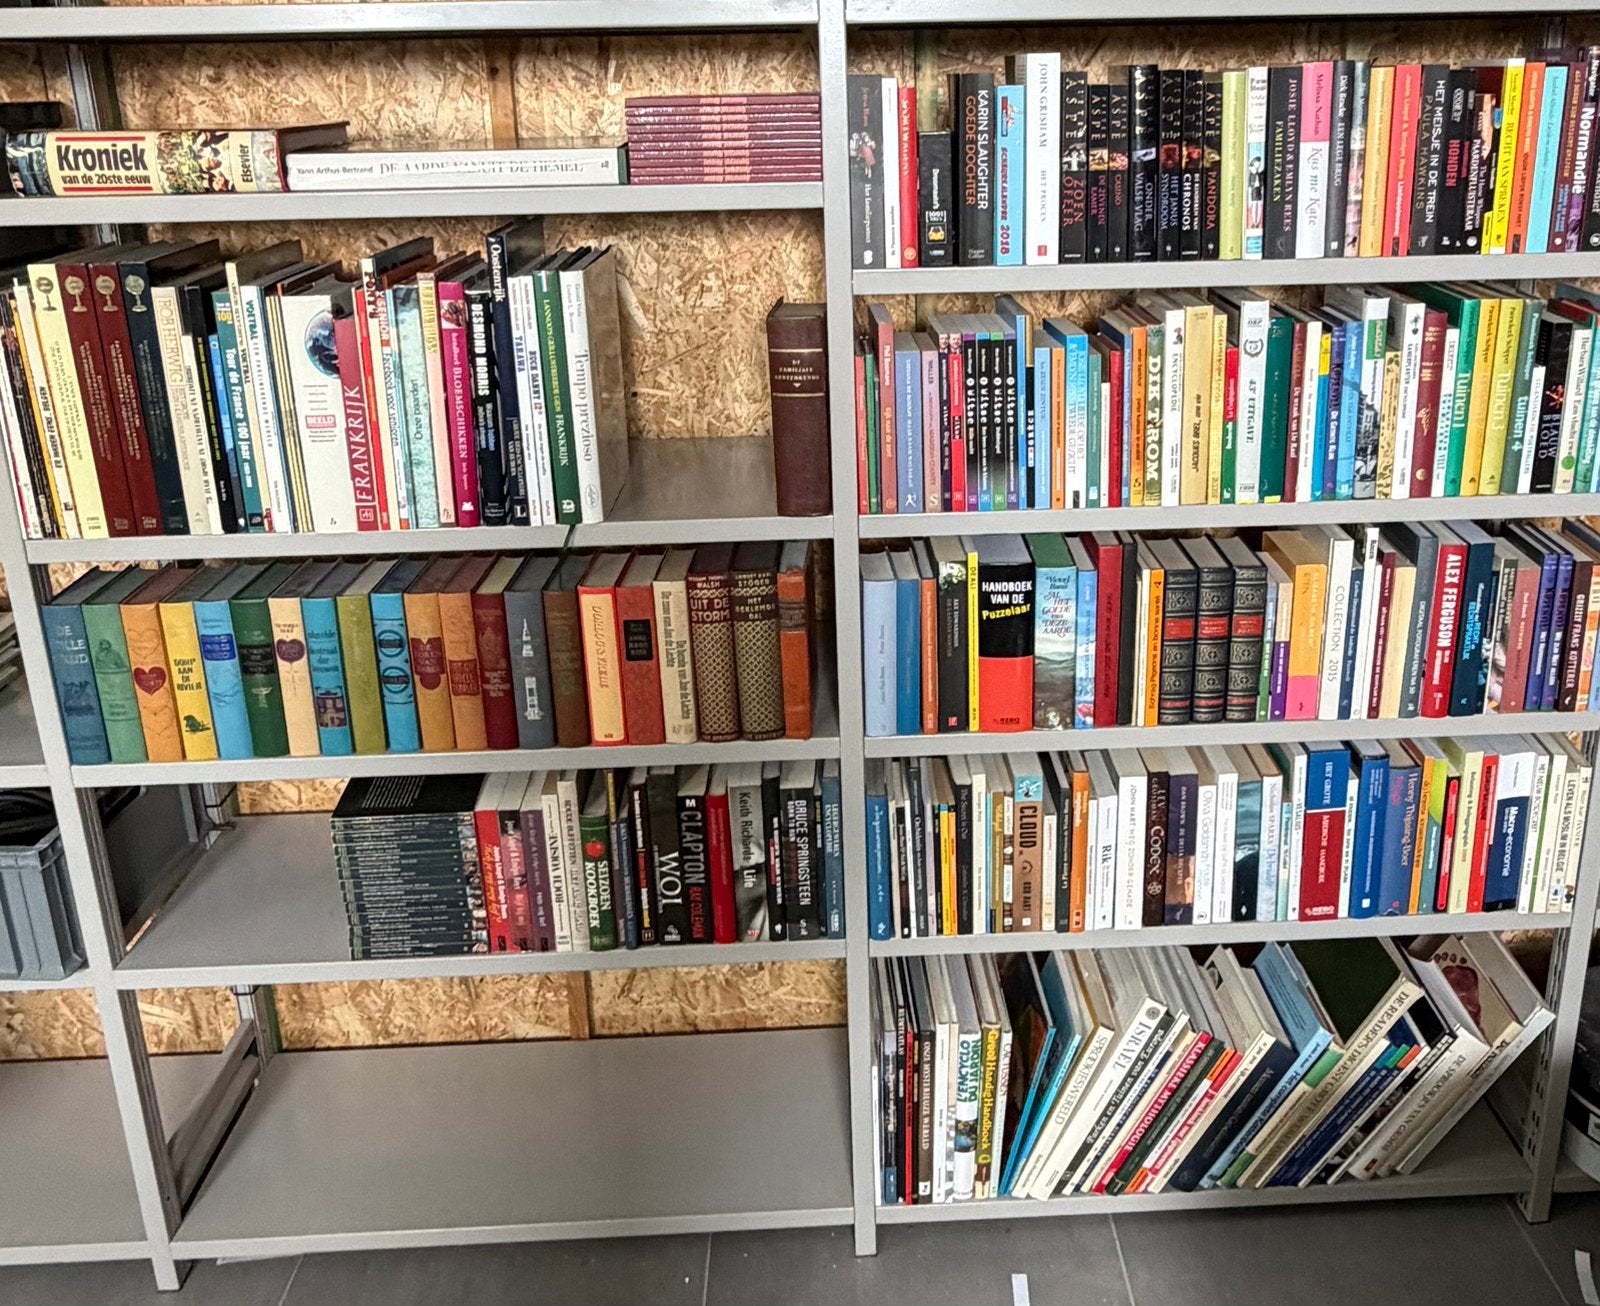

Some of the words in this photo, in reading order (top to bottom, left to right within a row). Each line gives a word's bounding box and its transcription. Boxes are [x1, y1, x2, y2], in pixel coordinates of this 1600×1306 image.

[1039, 63, 1048, 93] JOHN
[1288, 78, 1297, 111] JOSIE
[1436, 80, 1445, 102] HET
[1588, 59, 1600, 97] Navigator
[965, 96, 976, 141] GOEDE
[977, 90, 989, 130] KARIN
[1065, 77, 1077, 139] ASPE
[1091, 95, 1101, 140] ASPE
[1111, 95, 1120, 140] ASPE
[1135, 70, 1147, 135] ASPE
[1162, 77, 1173, 139] ASPE
[1206, 92, 1215, 138] ASPE
[1420, 95, 1433, 139] PAULA
[1039, 96, 1048, 148] GRISHAM
[1286, 115, 1295, 151] LLOYD
[1431, 107, 1443, 151] MEISJE
[1503, 122, 1516, 156] RECHT
[57, 143, 148, 172] Kroniek
[239, 143, 253, 183] Elsevier
[1272, 121, 1283, 202] FAMILIEZAKEN
[1310, 148, 1323, 170] Kus
[1430, 155, 1440, 166] IN
[1445, 139, 1460, 187] HONDEN
[1501, 160, 1512, 177] VAN
[1573, 108, 1595, 194] Normandië
[62, 176, 78, 185] van
[81, 174, 93, 184] de
[96, 174, 122, 184] 20ste
[124, 175, 151, 183] eeuw
[965, 144, 976, 205] DOCHTER
[977, 133, 988, 209] SLAUGHTER
[1134, 172, 1143, 202] VALSE
[1170, 176, 1178, 193] HET
[1284, 164, 1294, 200] EMLYN
[1310, 175, 1319, 192] me
[1416, 147, 1429, 210] HAWKINS
[1428, 170, 1439, 186] DE
[1464, 139, 1481, 230] PAARDENFLUISTERAAR
[1074, 179, 1084, 223] ZOEN
[1145, 182, 1153, 221] ONDER
[1160, 173, 1169, 229] SYNDROOM
[1169, 198, 1178, 226] JANUS
[1182, 174, 1191, 230] CHRONOS
[1206, 171, 1216, 229] PANDORA
[1283, 204, 1292, 232] REES
[1305, 198, 1321, 226] Kate
[1425, 189, 1437, 223] TREIN
[1497, 180, 1510, 223] SPREKEN
[1134, 205, 1143, 232] VLAG
[491, 244, 505, 302] Oostenrijk
[157, 299, 174, 327] ROB
[246, 300, 258, 340] VOETBAL
[377, 300, 389, 340] SENIOR
[471, 303, 486, 354] DESMOND
[159, 328, 184, 383] HERWIG
[225, 348, 238, 368] Tour
[240, 348, 250, 384] VOETBAL
[515, 336, 526, 372] TARAWA
[529, 351, 539, 371] BUCK
[227, 371, 239, 383] de
[476, 357, 489, 395] MORRIS
[530, 373, 541, 400] DANNY
[572, 350, 590, 400] Tempo
[1147, 355, 1161, 404] DIK
[1170, 353, 1178, 412] ENCYCLOPEDIE
[1494, 369, 1512, 417] Tuinen
[228, 386, 244, 419] France
[409, 379, 421, 418] paarden
[1454, 370, 1471, 417] Tuinen
[234, 422, 248, 438] 100
[414, 419, 424, 440] Onze
[452, 366, 468, 458] BLOEMSCHIKKEN
[1246, 397, 1255, 443] UITGAVE
[1493, 420, 1505, 430] 3
[1513, 395, 1529, 438] tuinen
[235, 441, 251, 459] jaar
[343, 386, 373, 502] FRANKRIJK
[575, 404, 594, 462] prezioso
[1146, 407, 1160, 481] TROM
[1512, 441, 1523, 451] 4
[1538, 414, 1550, 459] BLOED
[1547, 413, 1560, 458] BLAUW
[982, 581, 1032, 592] HANDBOEK
[1444, 554, 1462, 583] ALEX
[690, 600, 709, 610] UIT
[713, 598, 729, 608] DE
[692, 610, 729, 622] STORM
[991, 594, 1009, 604] VAN
[1012, 594, 1024, 604] DE
[1573, 594, 1585, 622] GRIZZLY
[1330, 586, 1345, 652] COLLECTION
[1437, 588, 1458, 647] FERGUSON
[1570, 624, 1582, 648] FRANS
[1327, 660, 1339, 682] 2015
[1565, 651, 1578, 688] KOTTERER
[1325, 762, 1333, 778] HET
[1406, 773, 1418, 802] Henny
[739, 792, 752, 817] Keith
[1129, 784, 1137, 805] JOHN
[1157, 790, 1166, 809] LEV
[1202, 791, 1213, 816] Olivia
[1268, 783, 1278, 814] Nicholas
[1323, 779, 1332, 805] GROTE
[1563, 802, 1574, 815] ALS
[1565, 780, 1576, 801] LEVEN
[788, 819, 795, 827] TO
[795, 800, 808, 834] BRUCE
[831, 804, 840, 857] LEGERGEWEREN
[1019, 806, 1037, 848] CLOUD
[1129, 807, 1137, 826] HART
[1266, 815, 1276, 845] SPARKS
[1559, 816, 1571, 842] MOSLIM
[680, 811, 706, 884] CLAPTON
[741, 821, 754, 861] Richards
[1101, 845, 1113, 864] Rik
[1201, 818, 1211, 863] Goldsmith
[1501, 807, 1519, 877] Macro-economie
[743, 870, 756, 888] Life
[796, 837, 811, 905] SPRINGSTEEN
[1127, 848, 1135, 877] ZONDER
[584, 862, 600, 928] KOOKBOEK
[597, 861, 611, 910] SEIZOEN
[689, 887, 701, 900] RAY
[1126, 879, 1134, 908] GENADE
[691, 903, 704, 939] COLEMAN
[1393, 991, 1409, 1005] DE
[986, 1030, 999, 1061] Groot
[1112, 1021, 1152, 1070] ISRAEL
[1359, 1005, 1398, 1051] READER'S
[922, 1042, 931, 1060] ONZE
[969, 1040, 980, 1083] JARDIN
[1168, 1041, 1206, 1091] KLASSIEKE
[1330, 1049, 1361, 1084] DIGEST
[957, 1040, 970, 1102] L'ENCYCLO
[982, 1062, 996, 1097] Handig
[1000, 1043, 1012, 1097] CACTUSSEN
[1055, 1035, 1107, 1124] SPROOKJESWERELD
[922, 1063, 930, 1115] MYSTERIEUZE
[968, 1086, 979, 1102] DU
[922, 1117, 930, 1149] WERELD
[981, 1098, 994, 1149] Handboek
[1124, 1088, 1172, 1151] MYTHOLOGIE
